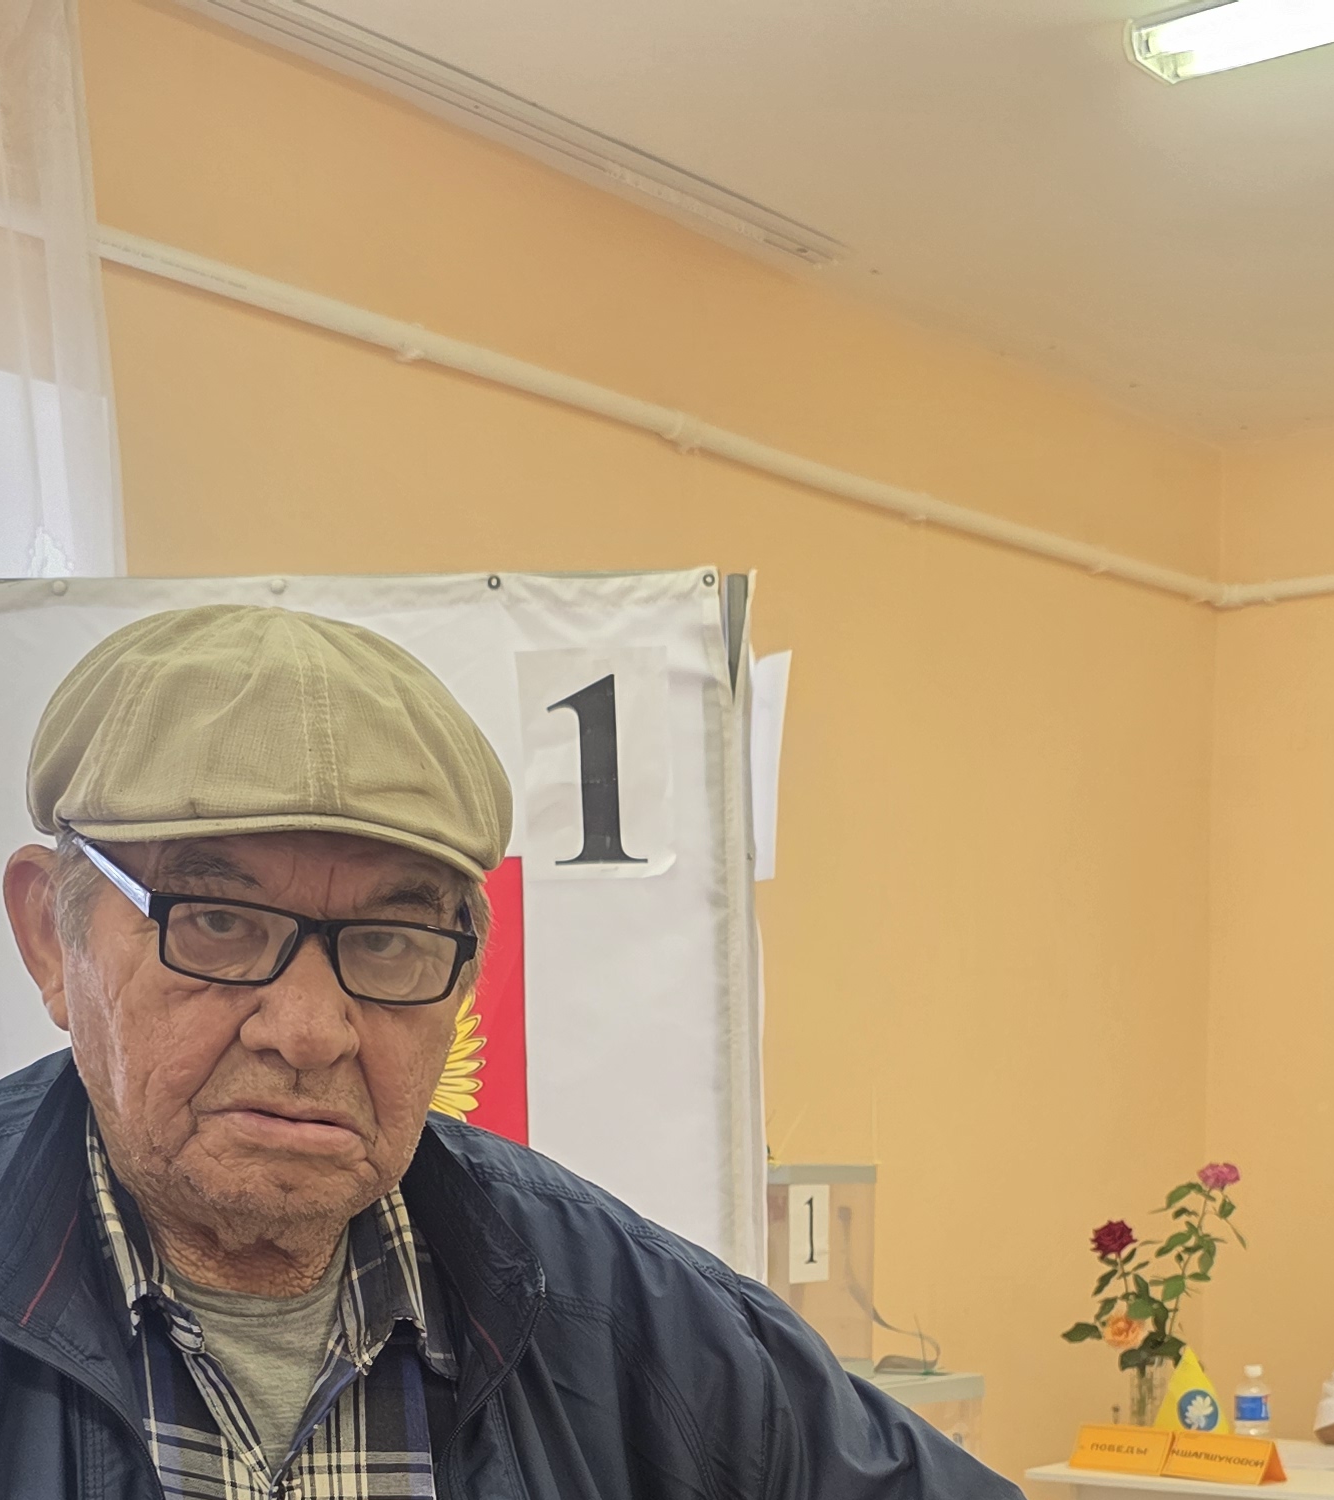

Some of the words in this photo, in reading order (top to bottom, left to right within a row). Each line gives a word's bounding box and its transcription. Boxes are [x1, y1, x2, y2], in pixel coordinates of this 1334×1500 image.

[546, 673, 649, 866] 1
[803, 1195, 818, 1264] 1
[1090, 1442, 1148, 1456] ПОБЕДЫ
